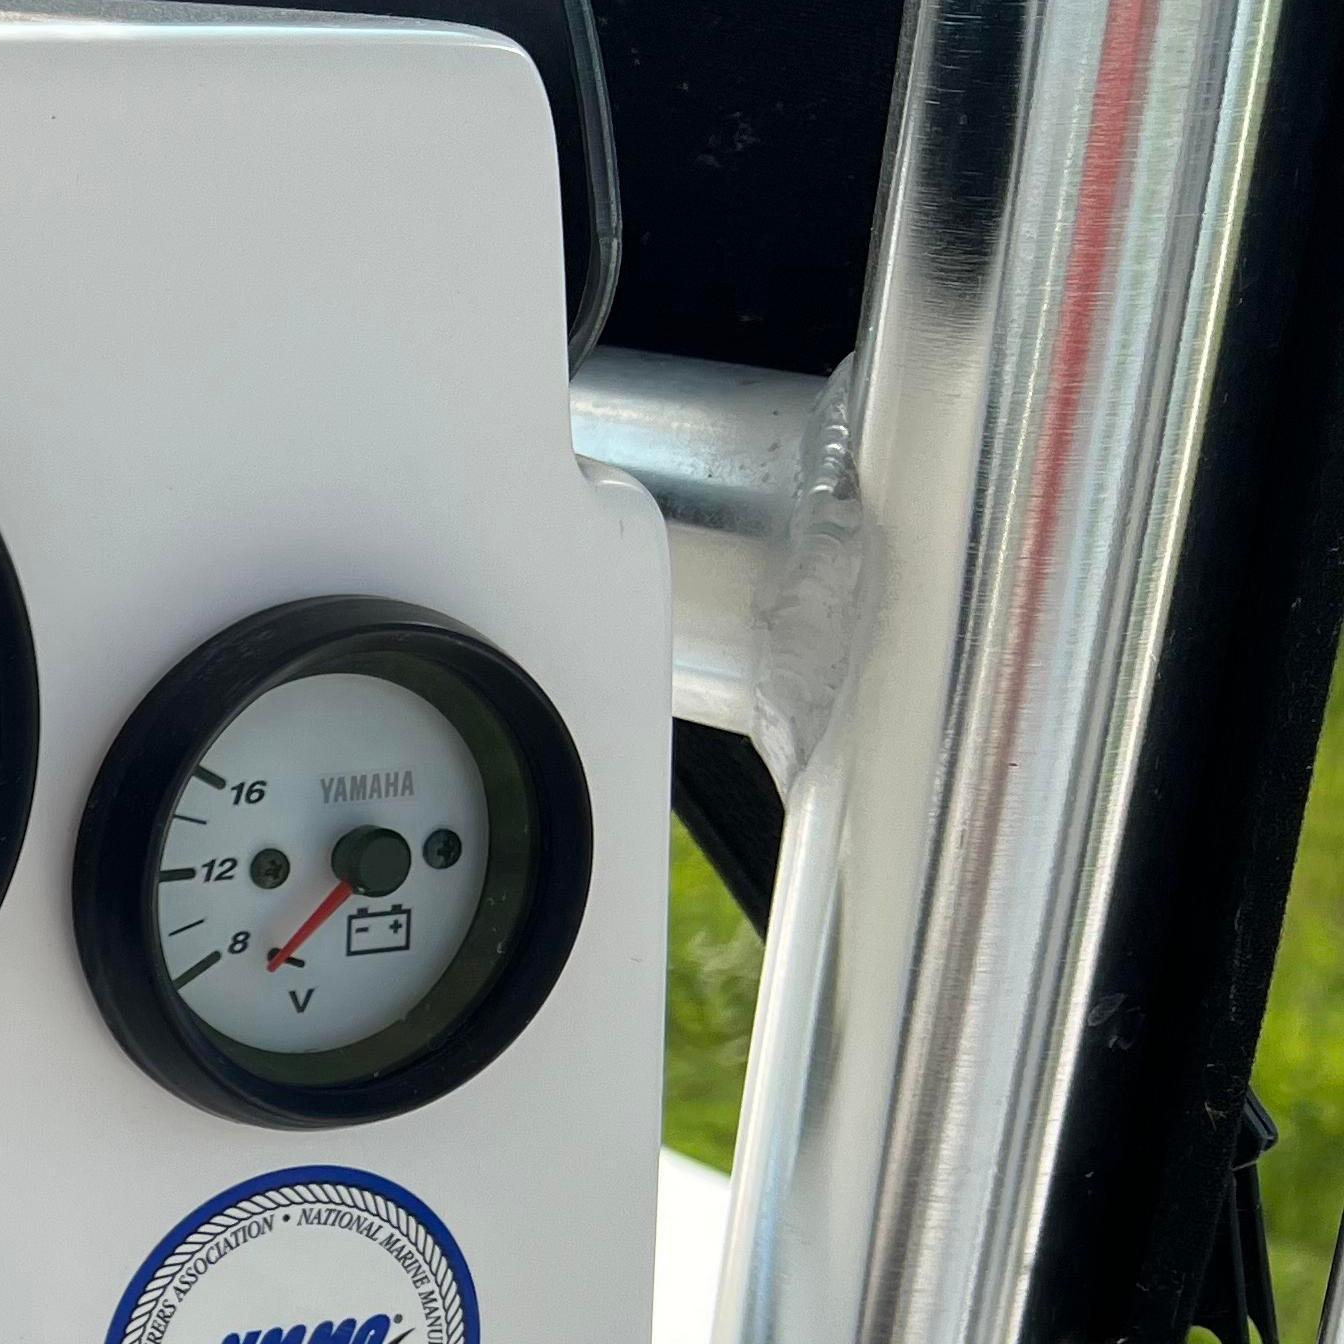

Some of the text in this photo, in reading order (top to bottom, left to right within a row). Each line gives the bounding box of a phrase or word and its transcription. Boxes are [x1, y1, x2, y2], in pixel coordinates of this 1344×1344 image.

[230, 780, 267, 806] 16
[321, 770, 415, 804] YAMAHA
[201, 858, 238, 882] 12
[228, 931, 250, 954] 8
[289, 988, 315, 1013] V
[174, 1214, 275, 1302] ASSOCIATION
[297, 1207, 382, 1242] NATIONAL
[379, 1234, 430, 1289] MARINE
